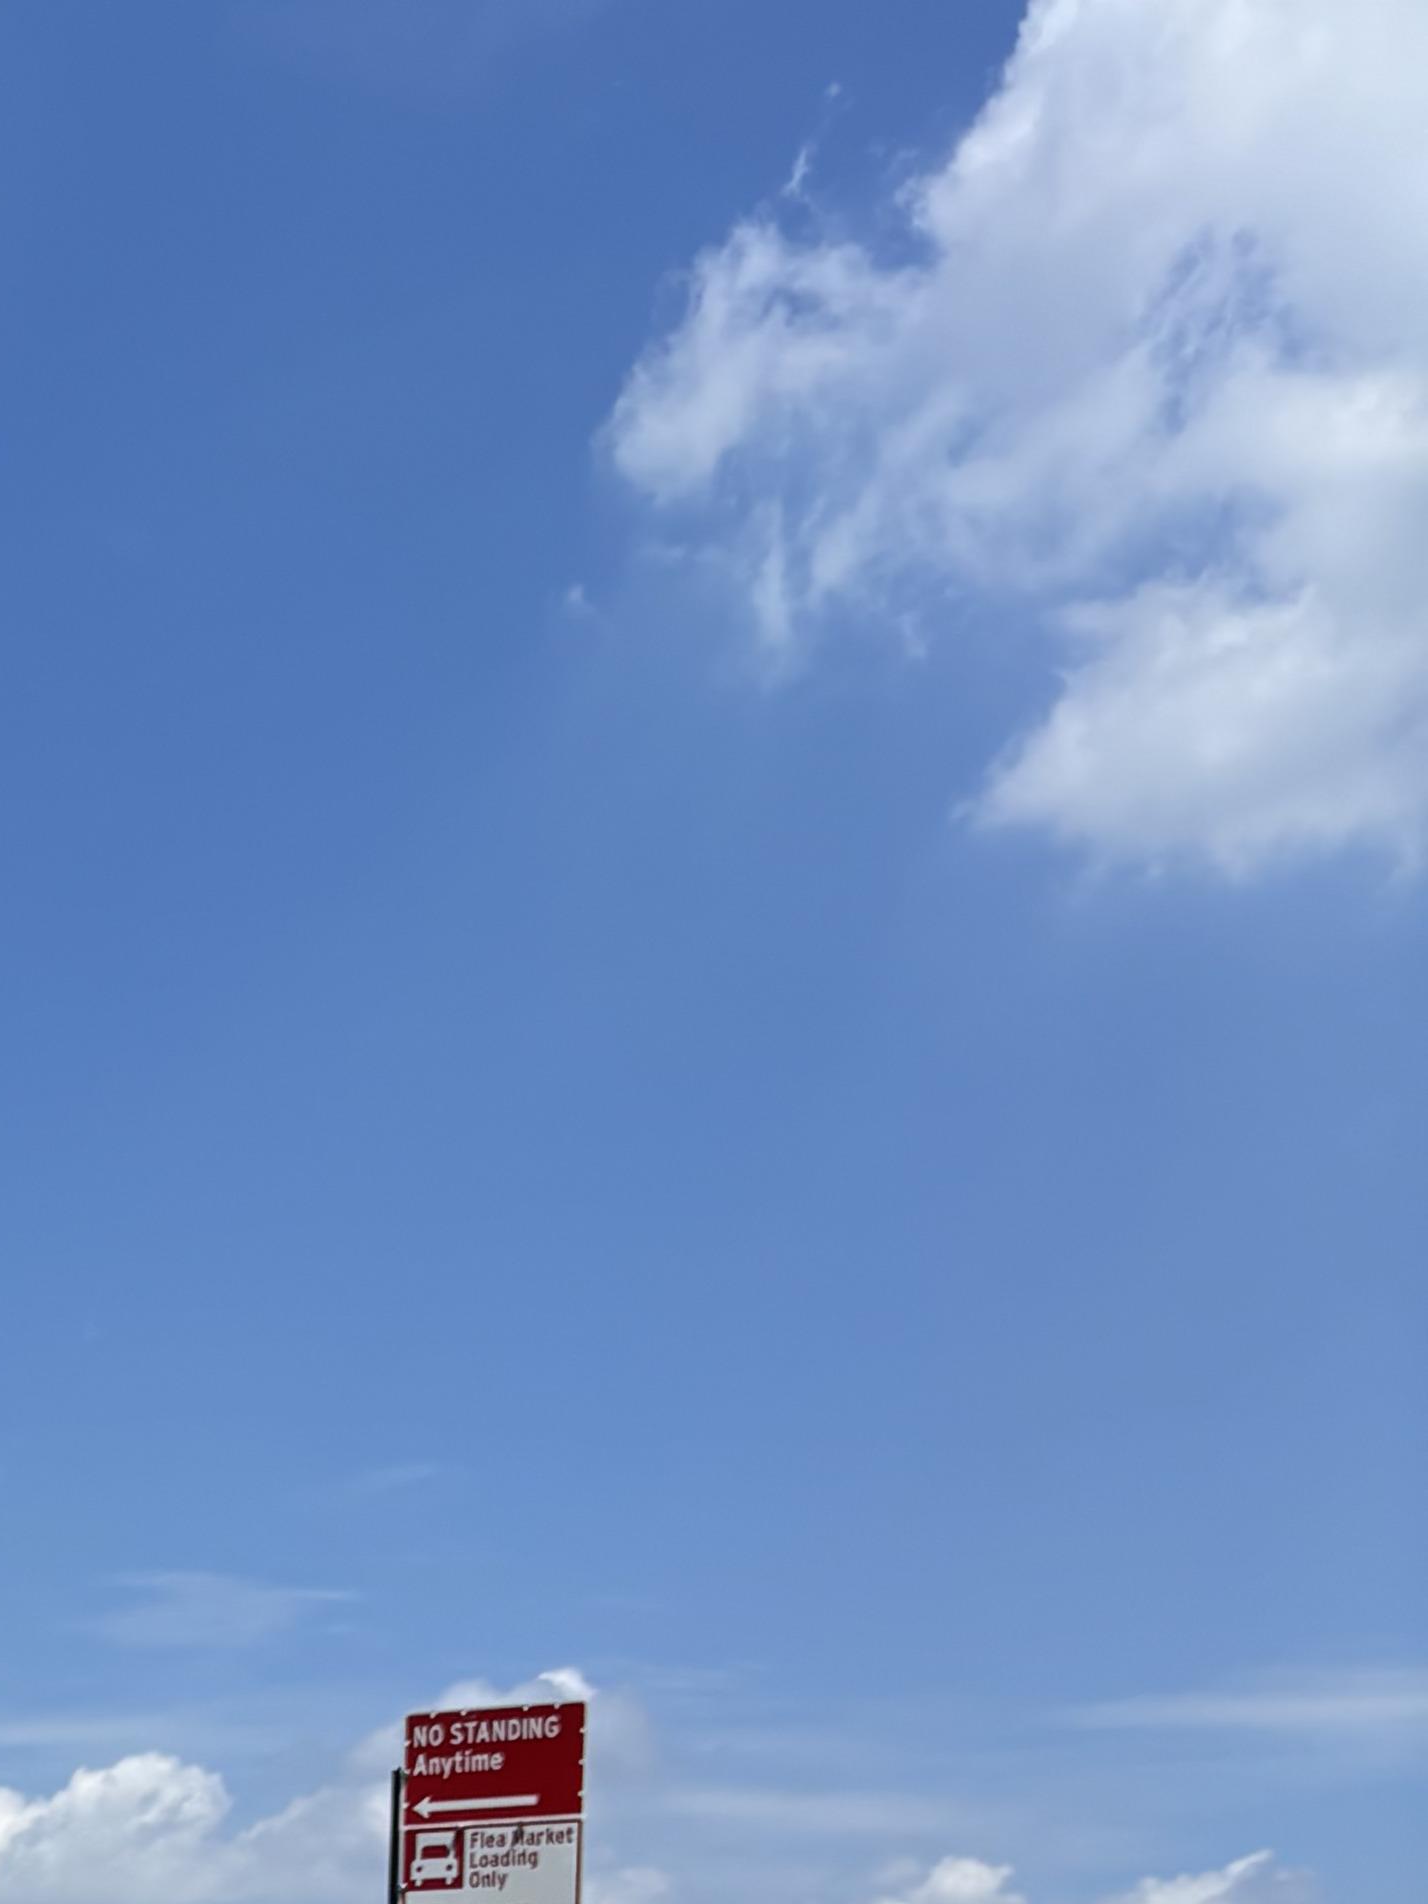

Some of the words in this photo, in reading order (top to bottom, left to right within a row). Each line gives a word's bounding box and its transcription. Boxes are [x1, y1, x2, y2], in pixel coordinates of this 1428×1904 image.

[413, 1724, 443, 1748] NO
[450, 1715, 561, 1746] STANDING
[413, 1749, 505, 1779] Anytime
[469, 1831, 506, 1849] Flea
[511, 1827, 574, 1847] Market
[469, 1849, 538, 1869] Loading
[469, 1871, 508, 1891] Only
